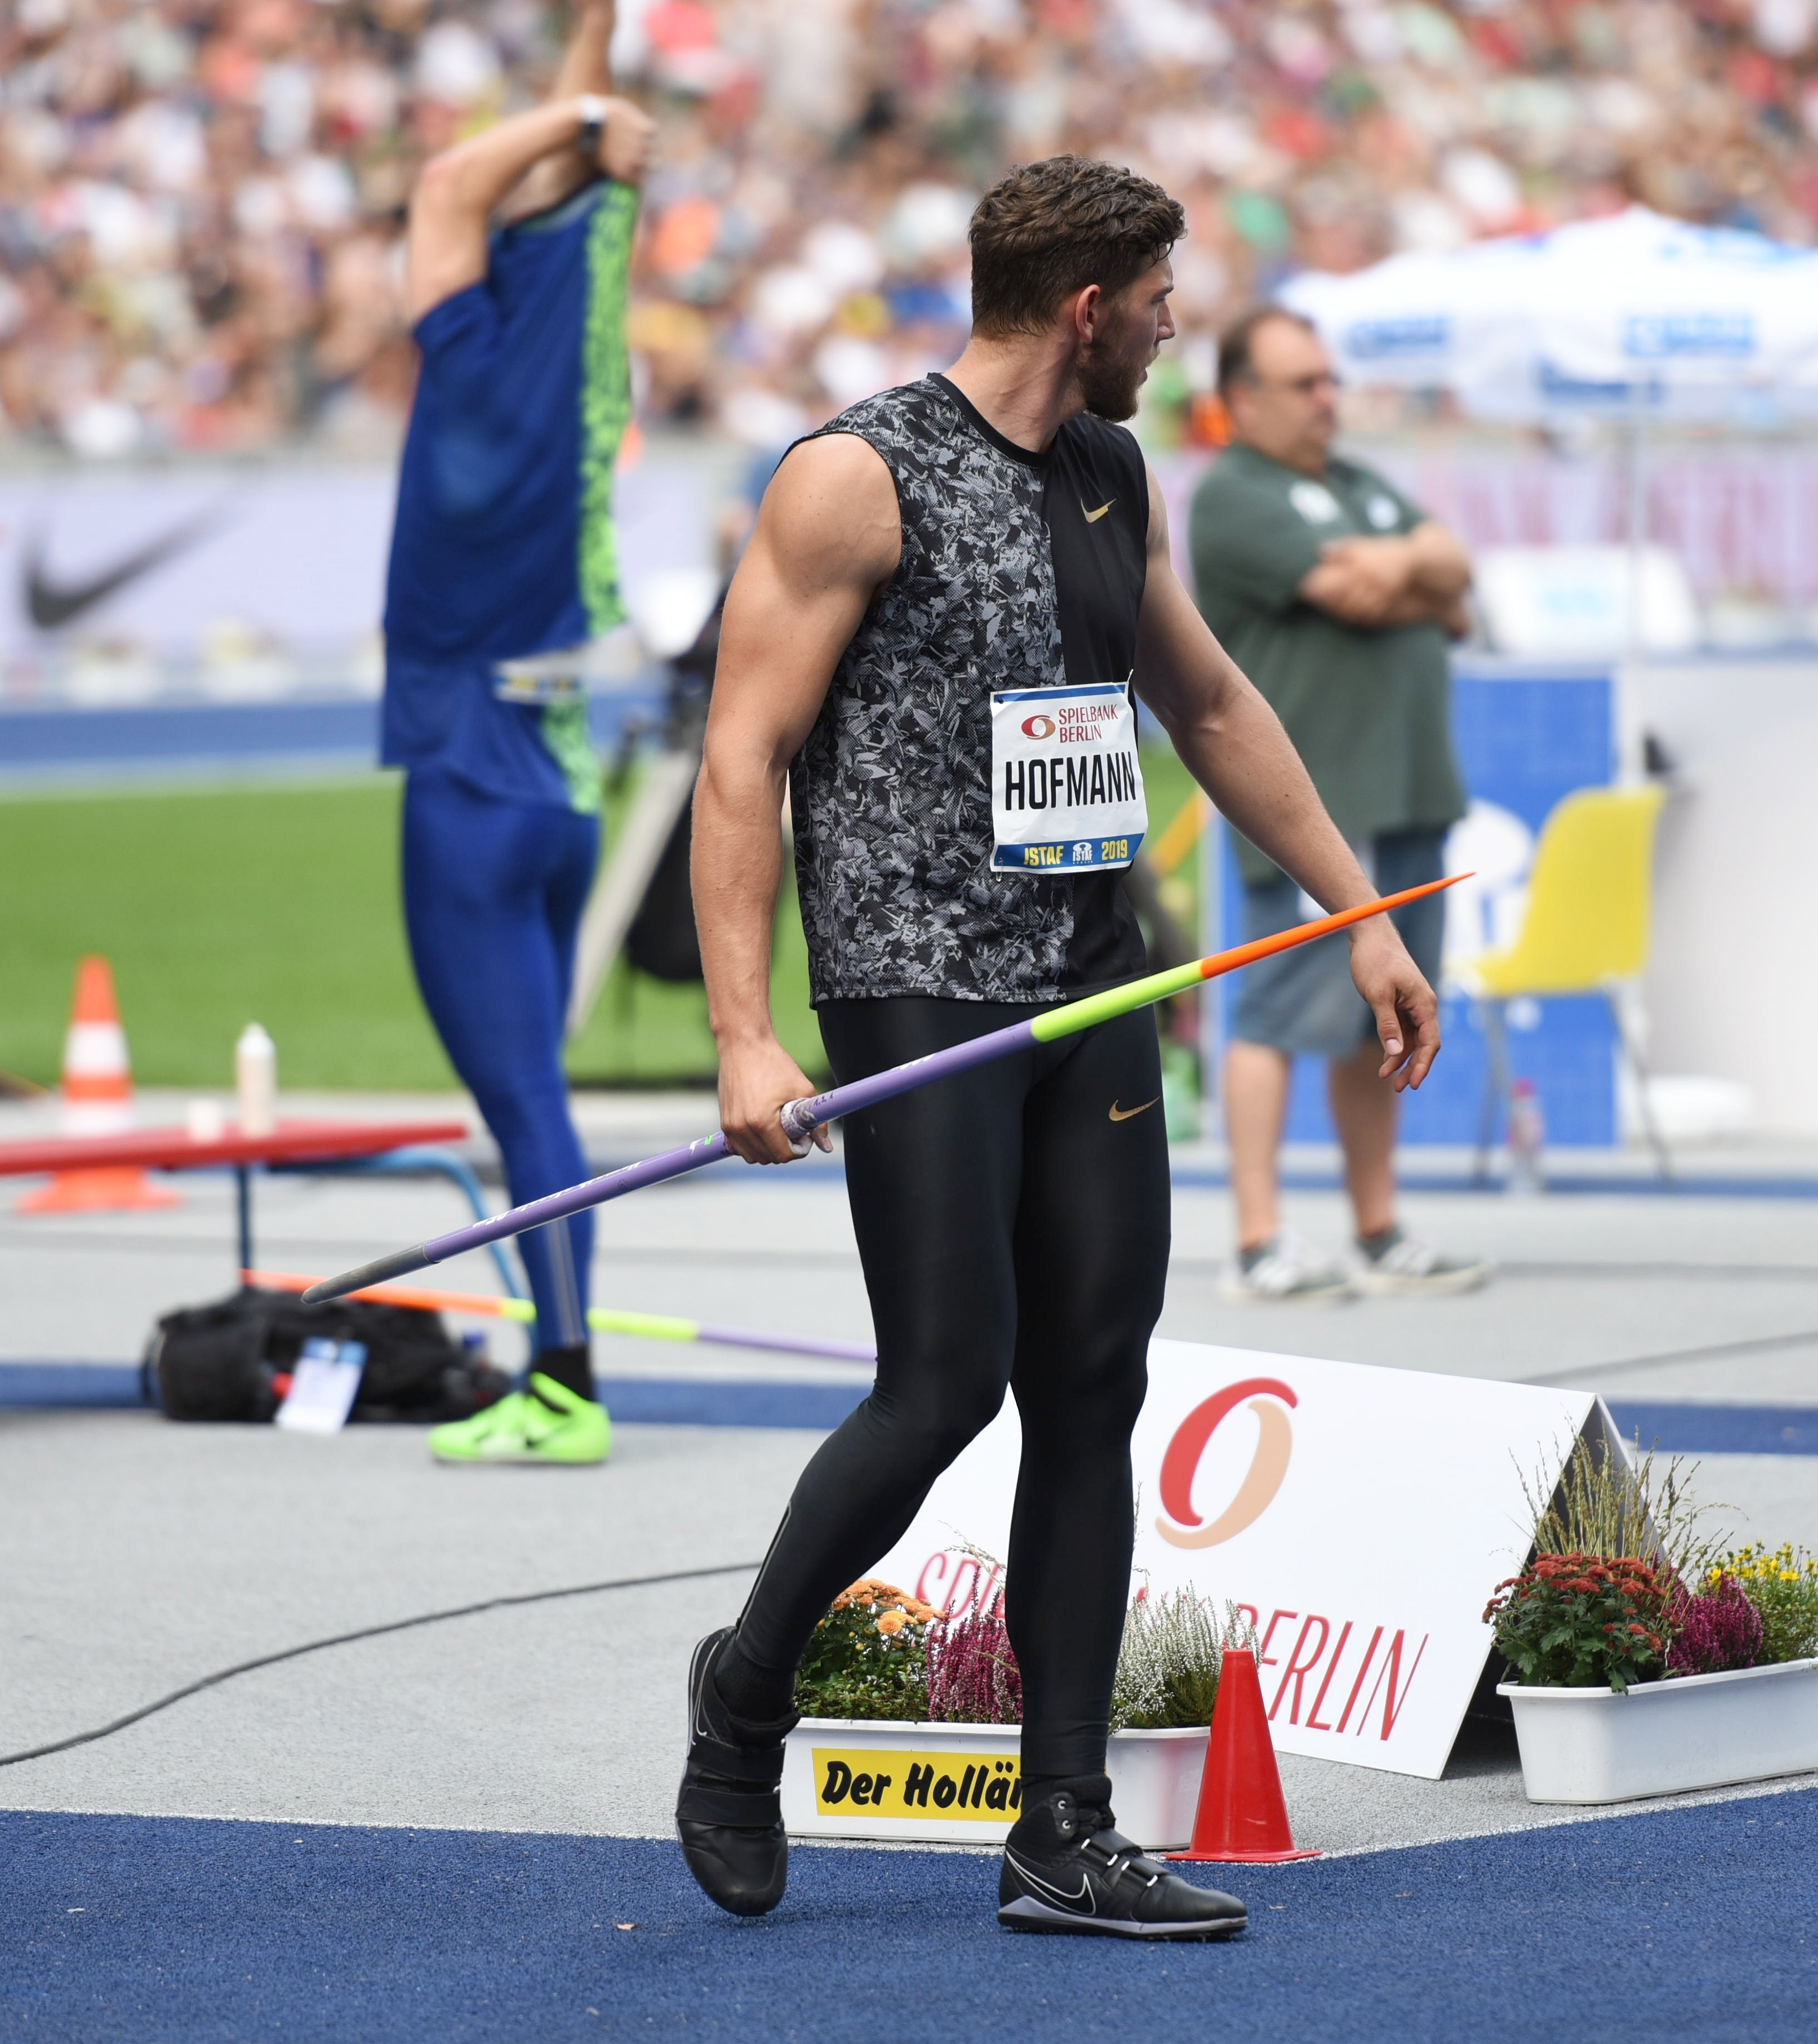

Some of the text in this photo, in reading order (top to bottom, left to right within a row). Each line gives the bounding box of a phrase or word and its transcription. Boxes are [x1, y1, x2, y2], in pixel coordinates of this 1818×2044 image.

[1059, 704, 1119, 725] SPIELBANK
[1060, 724, 1102, 743] BERLIN
[1005, 751, 1136, 810] HOFMANN
[1024, 839, 1128, 866] ISTAF 2019
[1072, 850, 1093, 862] ISTAF
[822, 1761, 892, 1806] Der
